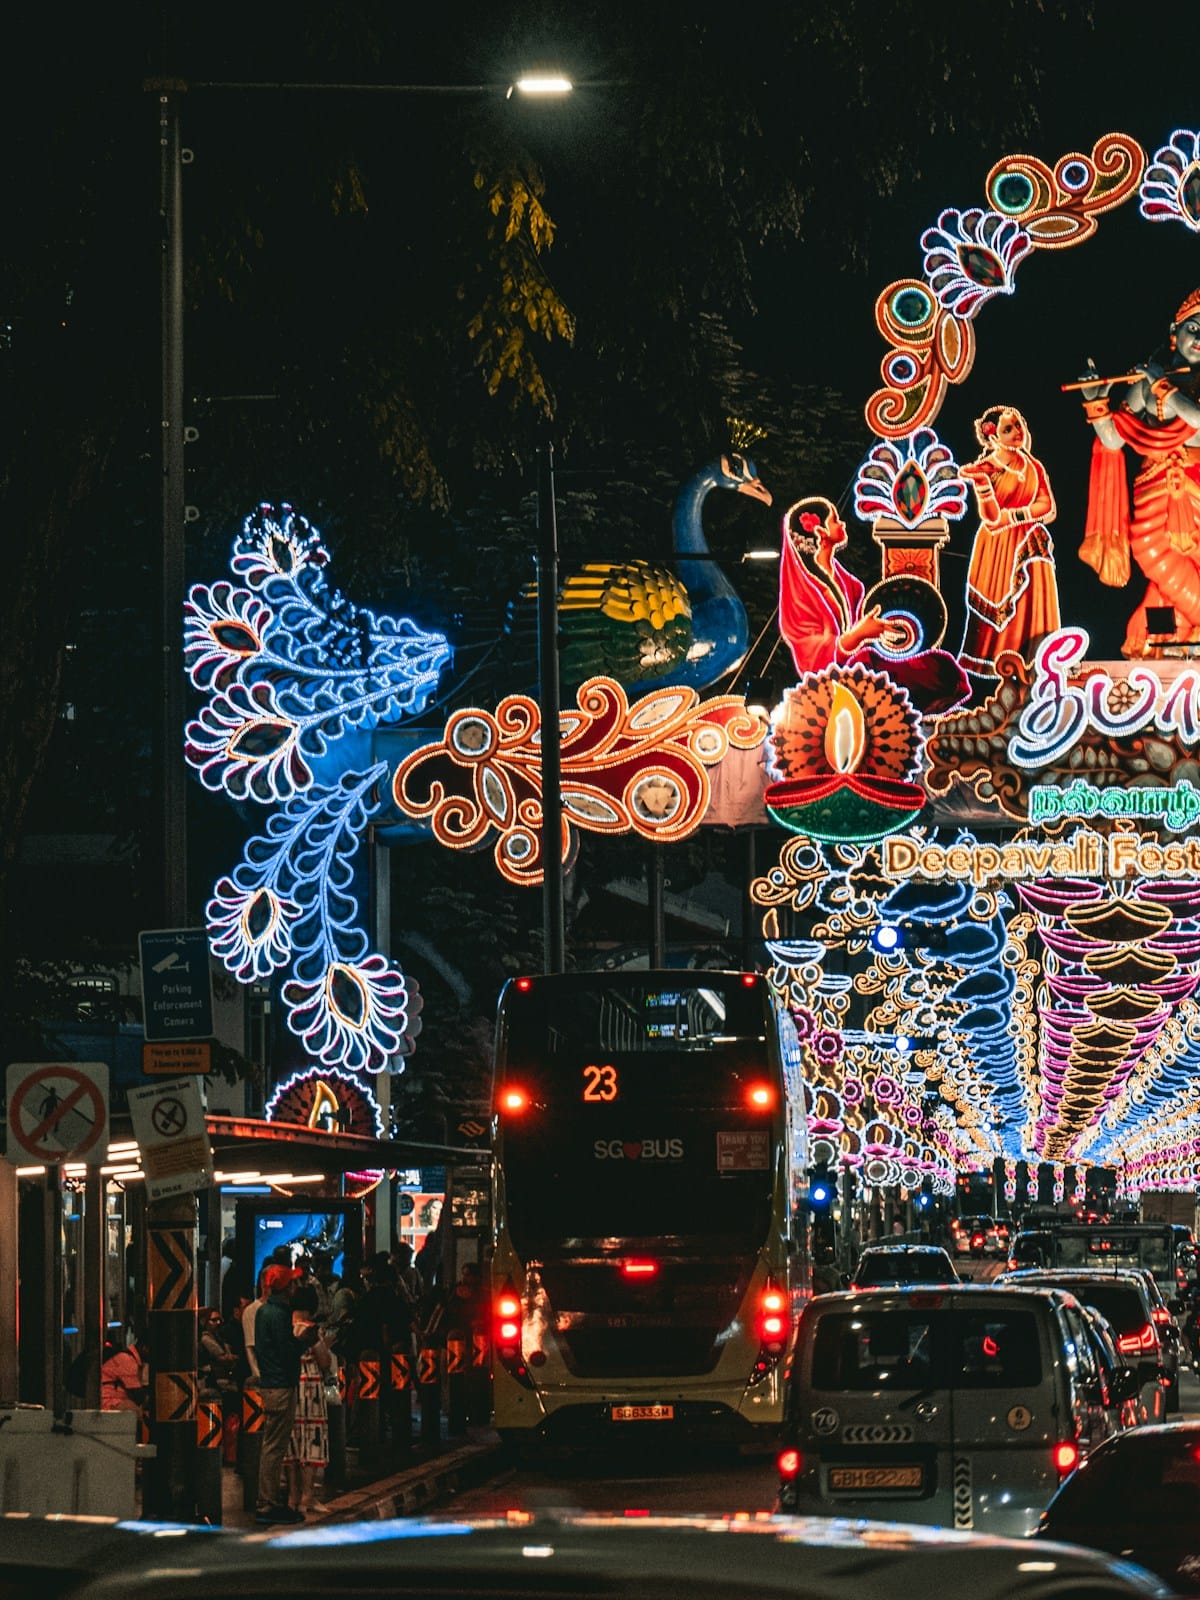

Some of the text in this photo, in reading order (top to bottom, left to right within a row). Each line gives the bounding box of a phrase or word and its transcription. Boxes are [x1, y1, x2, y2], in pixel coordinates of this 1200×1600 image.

[882, 832, 1102, 885] Deepavali
[162, 983, 192, 995] Parking
[153, 1000, 203, 1011] Enforcement
[163, 1016, 194, 1027] Camera
[583, 1064, 618, 1101] 23
[720, 1135, 766, 1145] THANK YOU
[593, 1138, 684, 1159] SG BUS
[616, 1407, 669, 1418] SG6333M
[817, 1413, 836, 1427] 70
